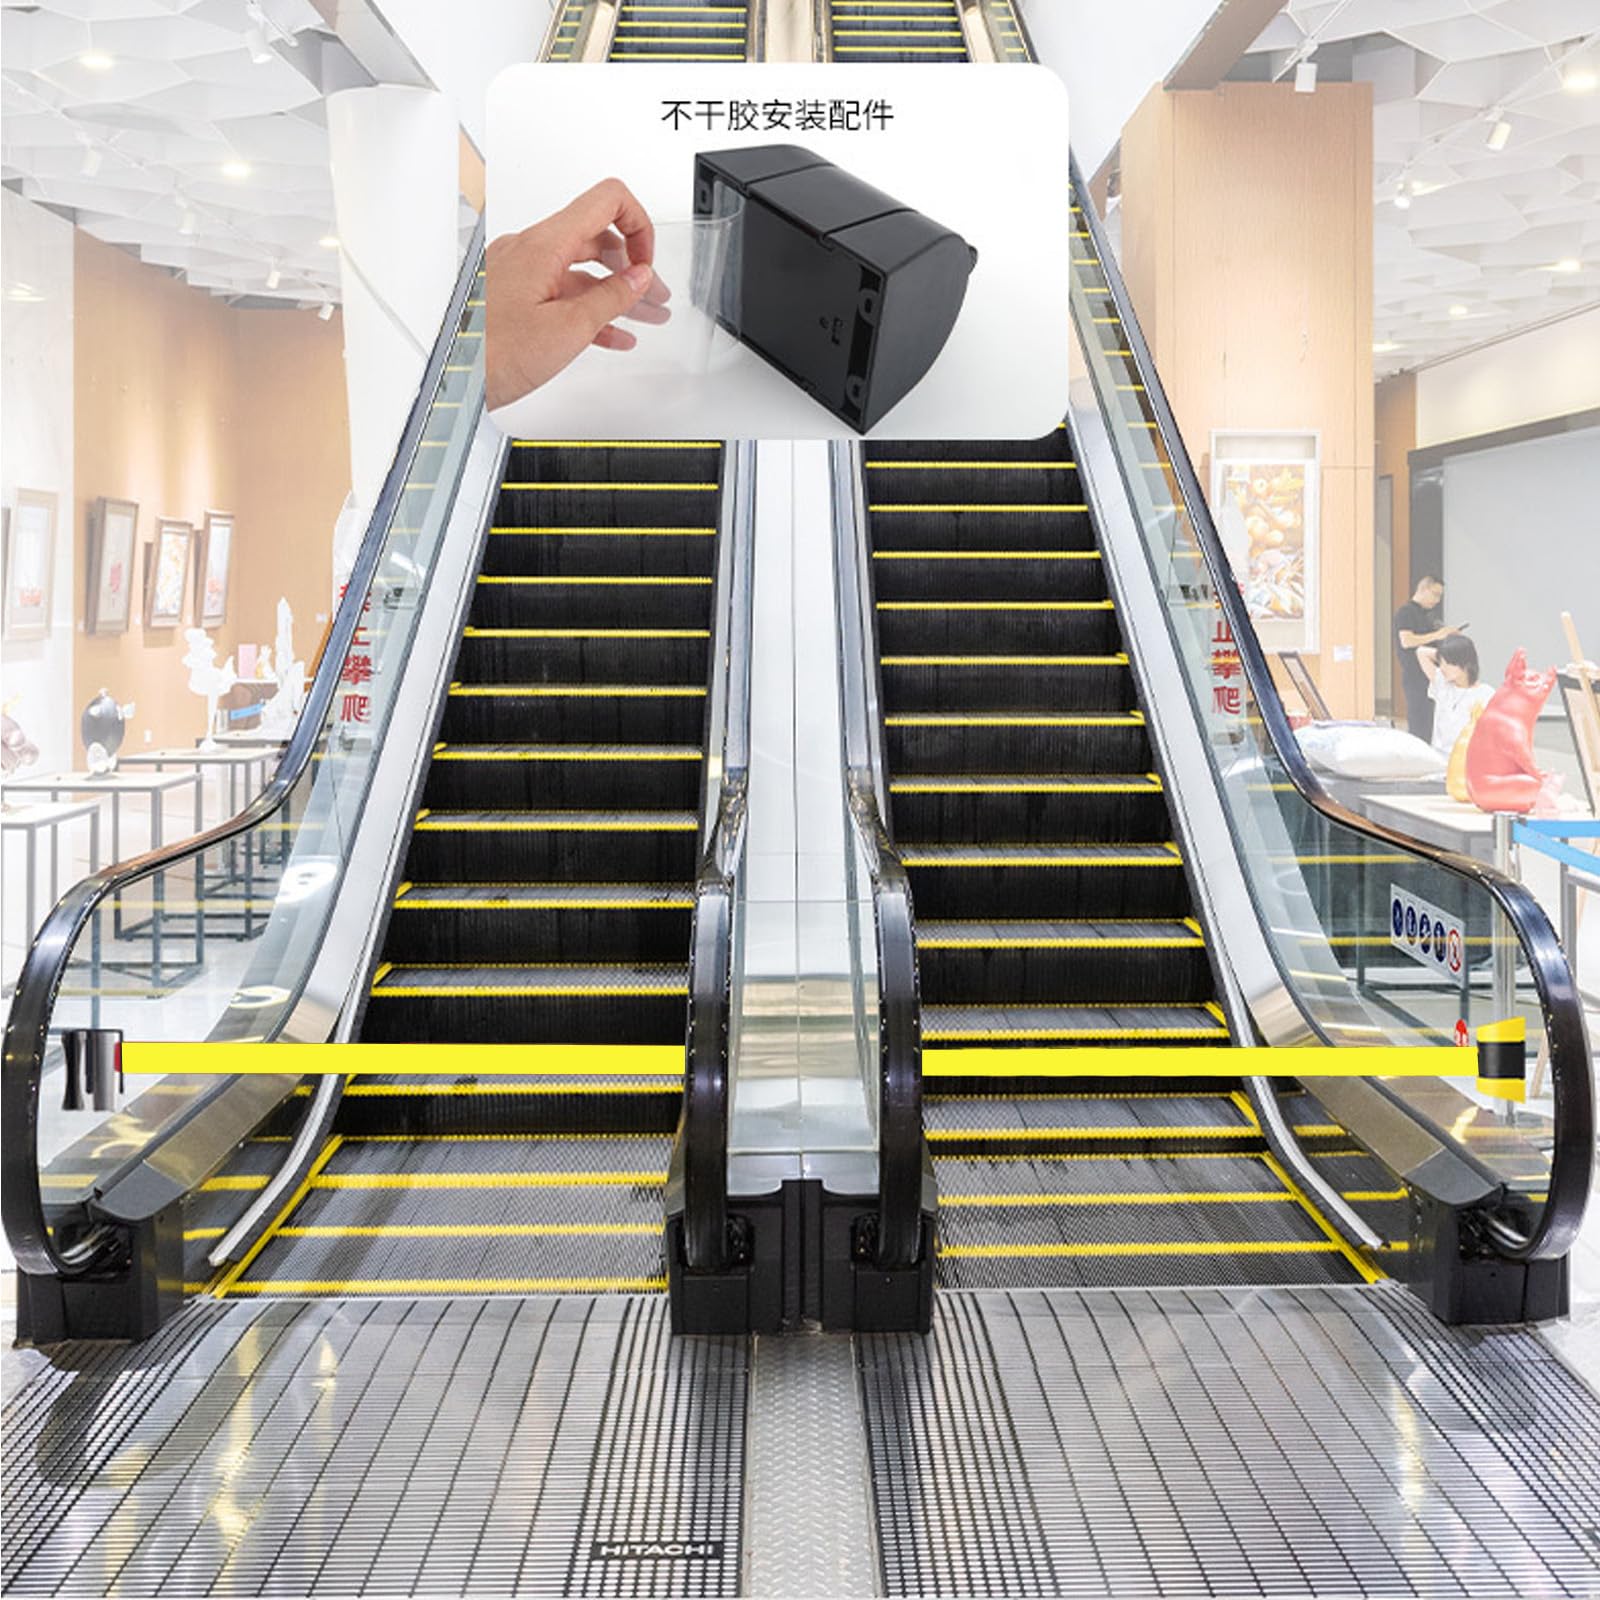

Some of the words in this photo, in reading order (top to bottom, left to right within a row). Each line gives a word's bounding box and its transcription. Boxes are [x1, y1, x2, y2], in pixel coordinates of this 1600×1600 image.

[1211, 583, 1244, 714] 止攀爬
[601, 1544, 713, 1555] HITACHI
